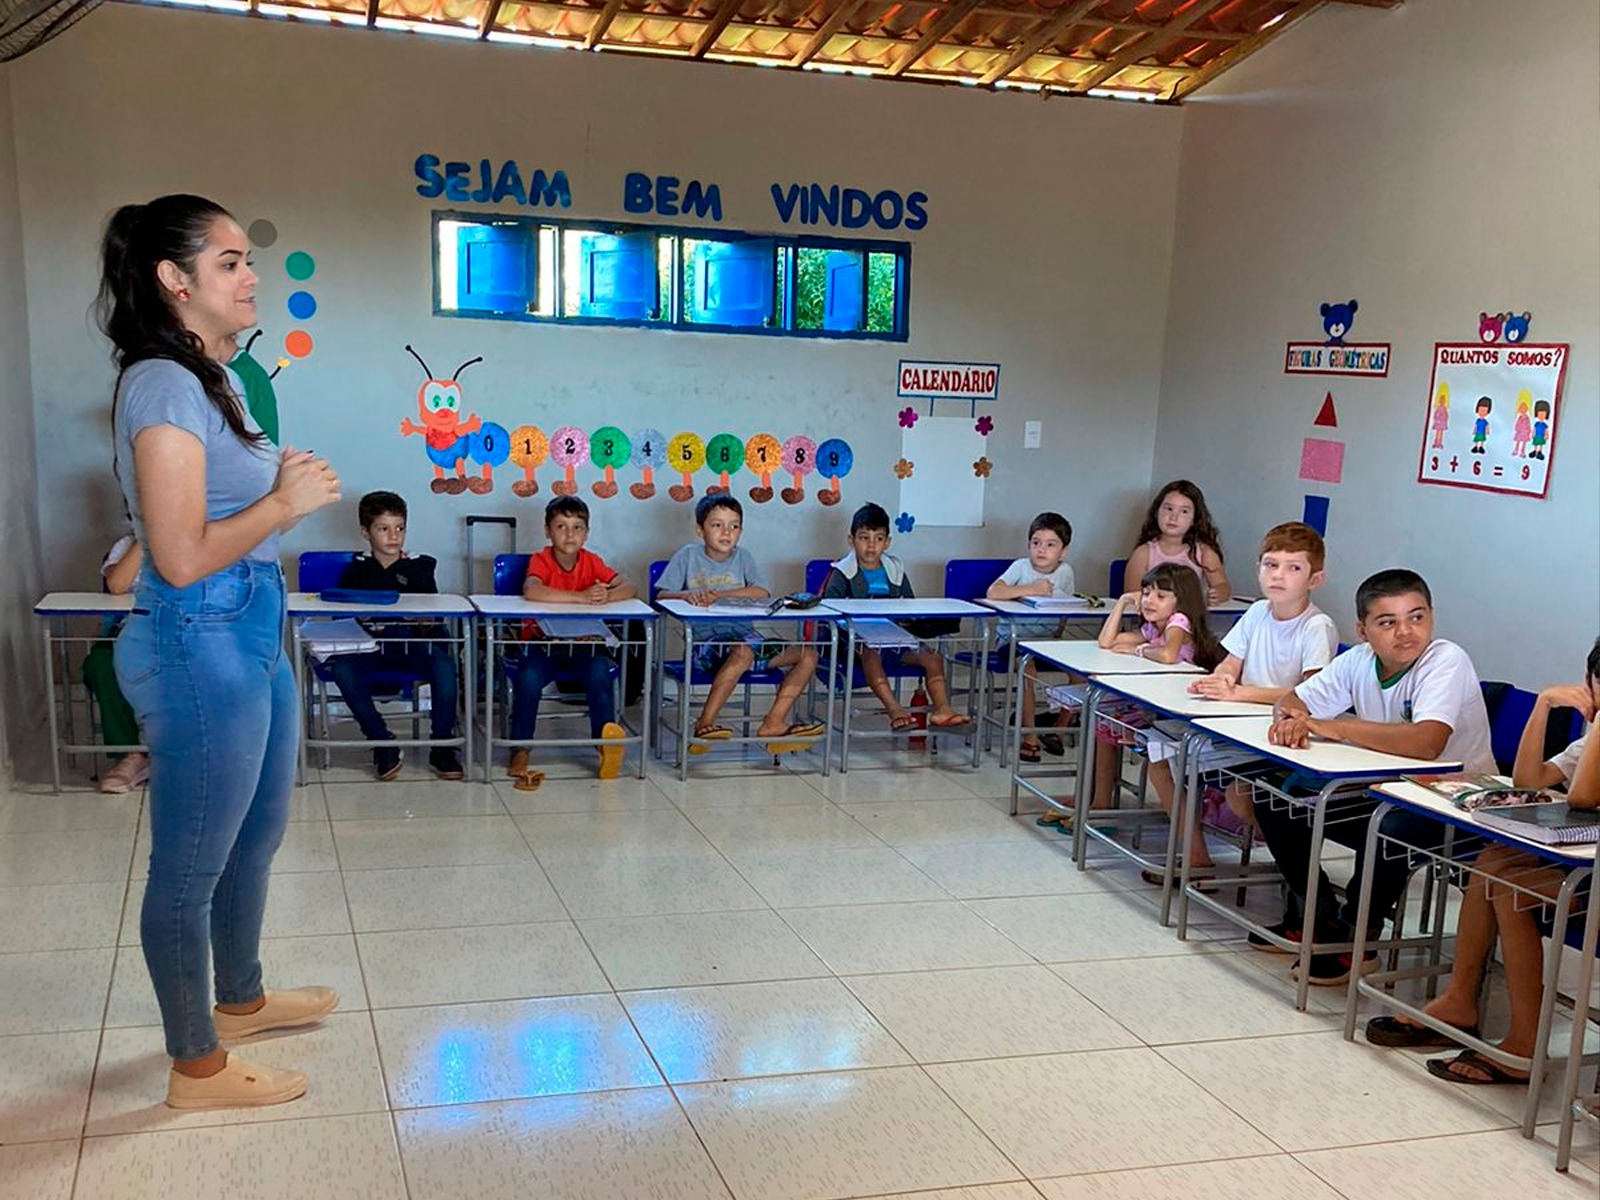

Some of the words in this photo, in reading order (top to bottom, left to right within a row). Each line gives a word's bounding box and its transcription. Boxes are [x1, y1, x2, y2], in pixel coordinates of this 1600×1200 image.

[414, 154, 572, 208] SEJAM
[623, 172, 723, 222] BEM
[771, 182, 929, 230] VINDOS
[1441, 350, 1499, 364] QUANTOS
[1507, 347, 1562, 367] SOMOS?
[902, 367, 995, 392] CALENDÁRIO
[484, 434, 494, 452] 0
[524, 438, 533, 455] 1
[565, 438, 576, 455] 2
[603, 440, 614, 456] 3
[642, 441, 652, 457] 4
[682, 444, 692, 461] 5
[720, 446, 730, 463] 6
[757, 447, 766, 463] 7
[795, 448, 806, 465] 8
[829, 452, 839, 467] 9
[1431, 456, 1439, 471] 3
[1473, 461, 1481, 475] 6
[1521, 466, 1530, 480] 9
